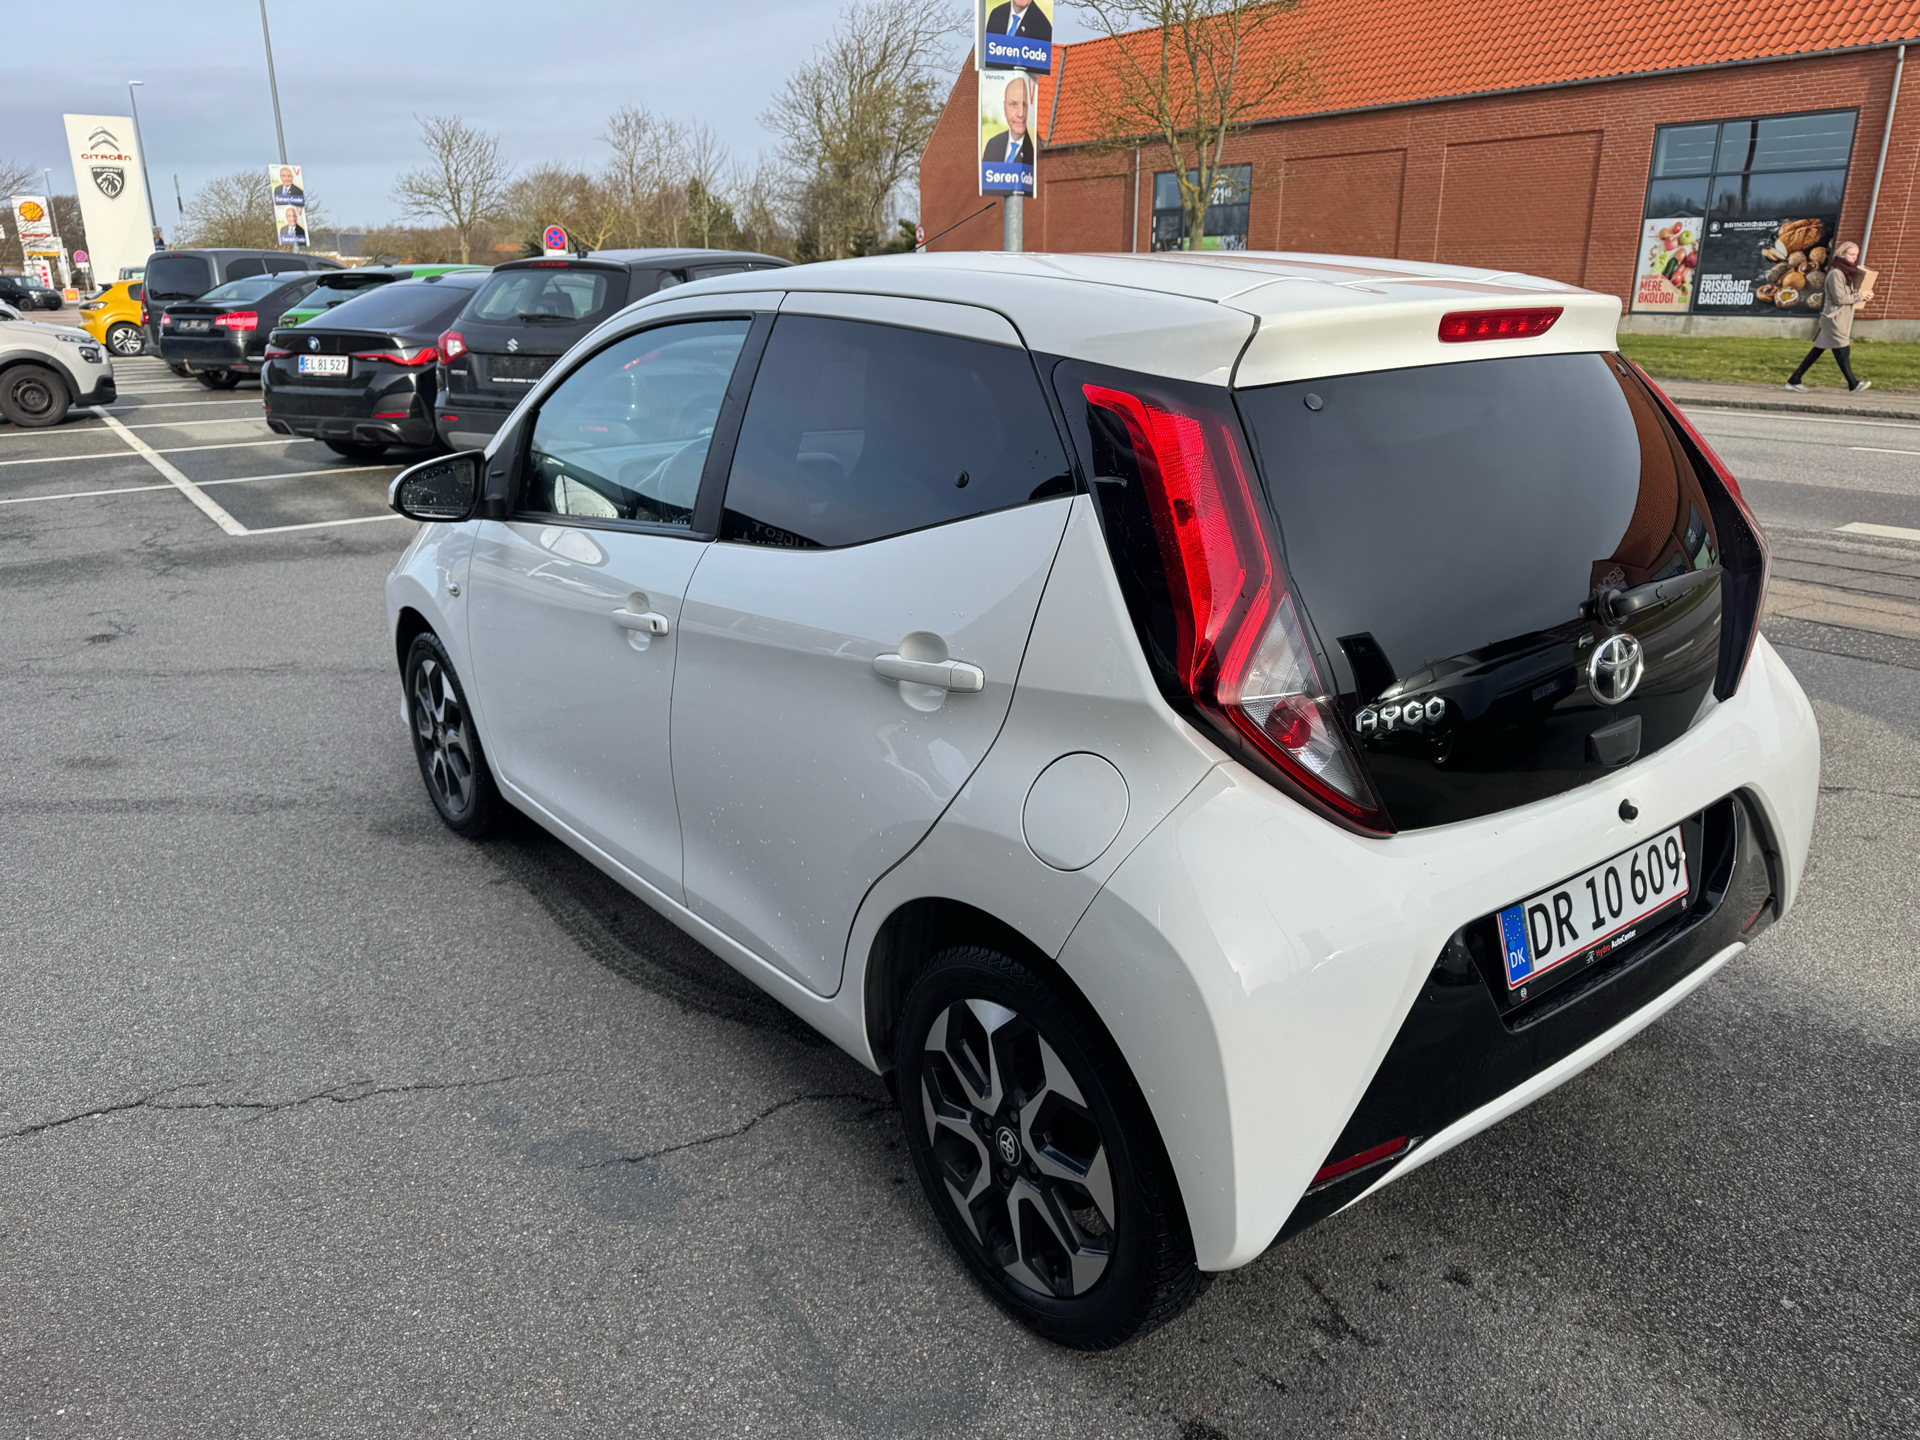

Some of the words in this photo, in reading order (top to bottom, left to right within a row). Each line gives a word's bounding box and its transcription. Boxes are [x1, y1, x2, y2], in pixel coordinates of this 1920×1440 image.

[988, 42, 1020, 57] Søren
[1021, 46, 1047, 62] Gade
[985, 169, 1019, 183] Søren
[1020, 171, 1033, 185] Gade
[1640, 280, 1663, 291] MERE
[1700, 280, 1751, 292] FRISKBAGT
[1638, 292, 1674, 303] ØKOLOGI
[1698, 292, 1754, 305] BAGERBRØD
[305, 359, 315, 369] EL
[318, 359, 327, 370] 81
[330, 360, 346, 370] 527
[1354, 695, 1446, 734] AYGO
[1528, 891, 1579, 960] DR
[1585, 866, 1622, 931] 10
[1630, 836, 1681, 905] 609
[1611, 929, 1636, 948] AutoCenter
[1510, 947, 1526, 968] DK
